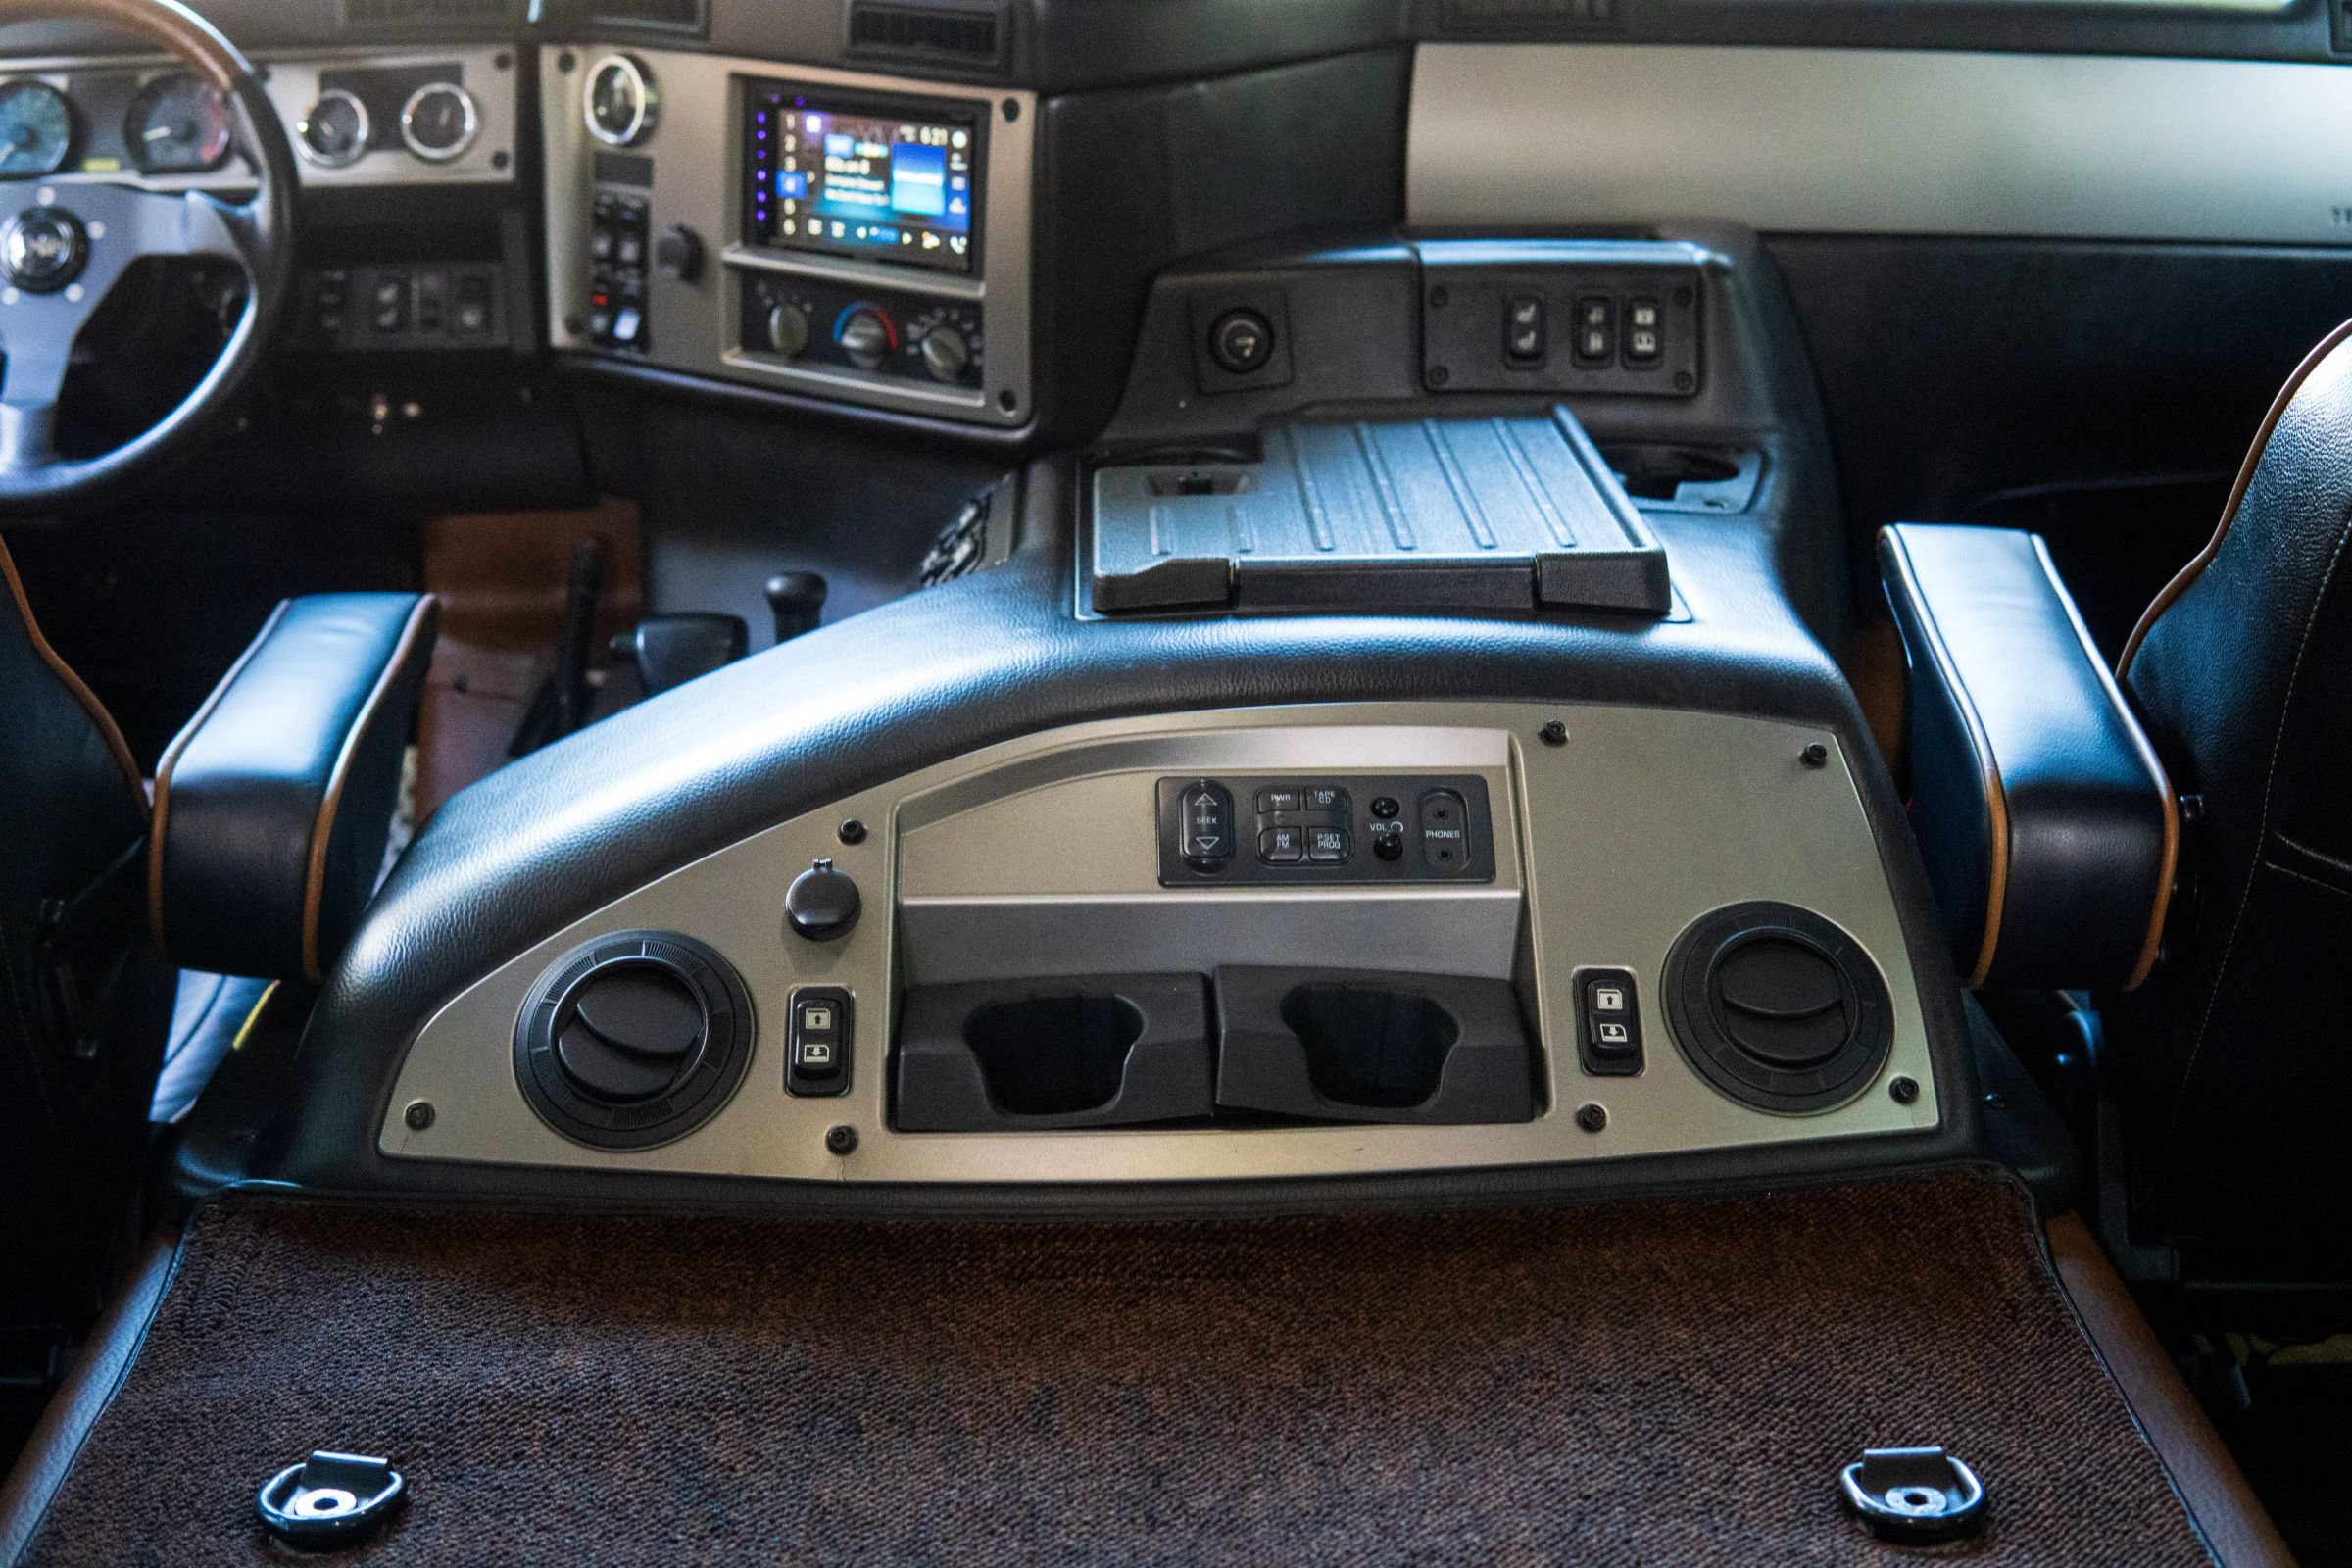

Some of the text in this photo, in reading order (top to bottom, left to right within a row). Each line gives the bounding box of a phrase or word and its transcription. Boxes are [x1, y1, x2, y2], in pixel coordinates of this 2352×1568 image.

[1270, 793, 1291, 802] PWR
[1196, 815, 1217, 825] SEEK
[1369, 822, 1387, 832] VOL
[1425, 830, 1460, 839] PHONES
